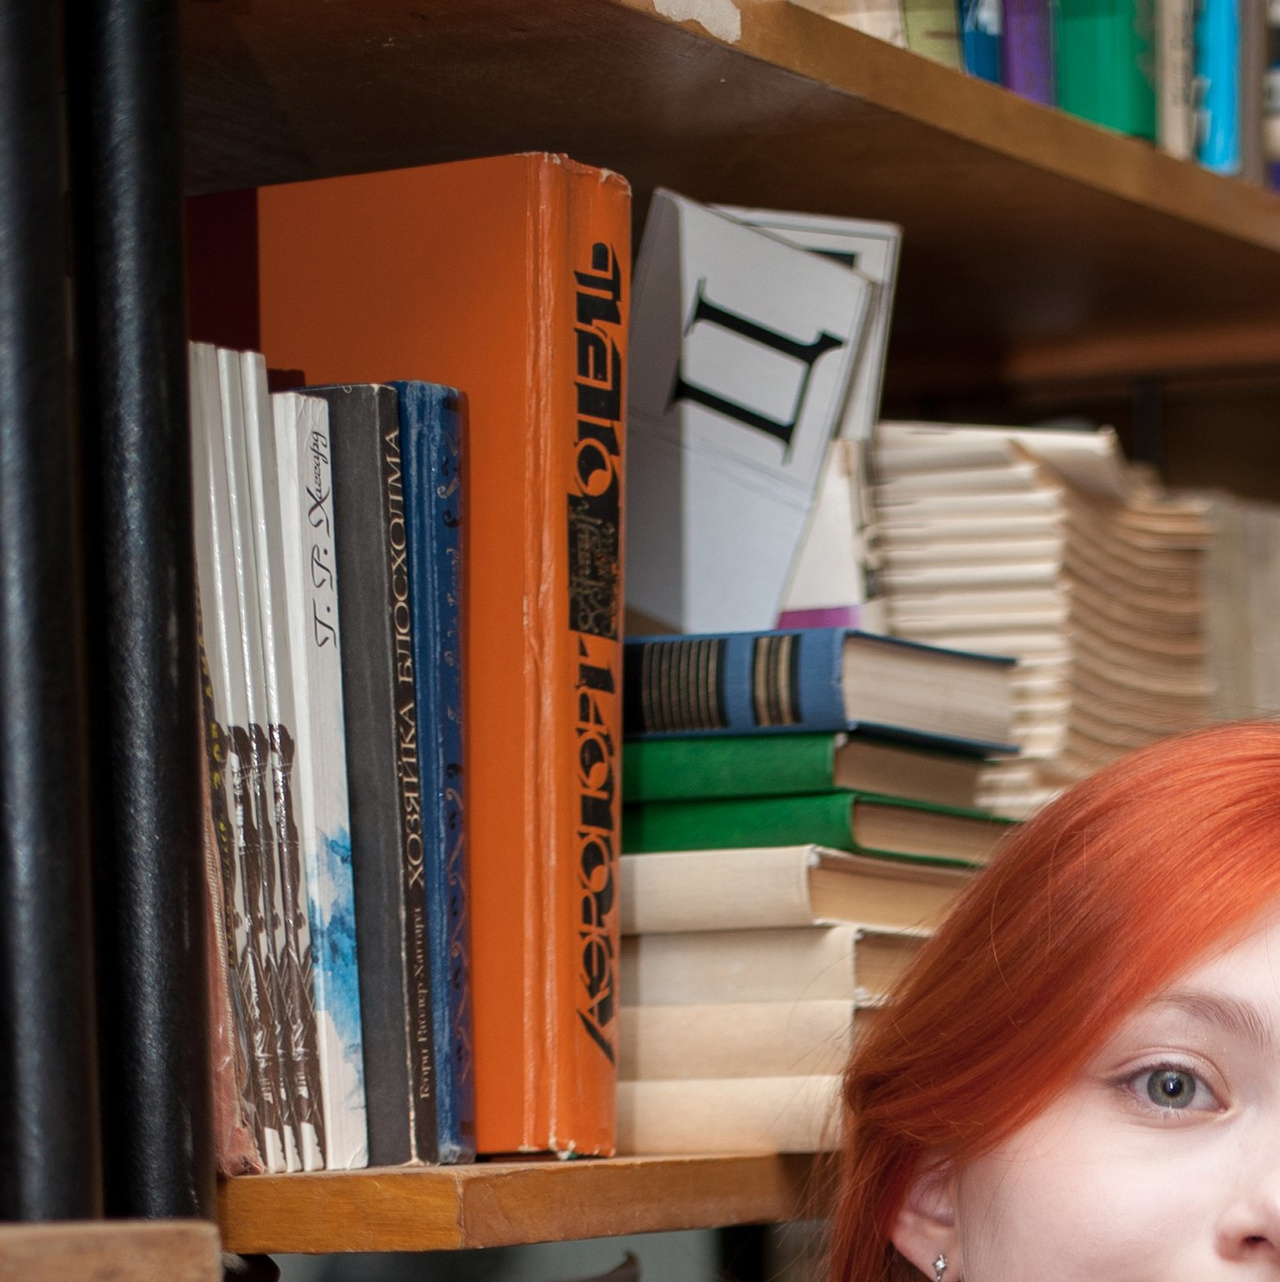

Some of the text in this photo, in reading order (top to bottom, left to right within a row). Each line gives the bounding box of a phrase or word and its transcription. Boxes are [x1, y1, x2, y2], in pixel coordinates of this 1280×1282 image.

[306, 431, 331, 538] Хаггард
[573, 241, 622, 497] ОТЕЛЬ
[311, 544, 334, 592] Р.
[384, 427, 425, 889] ХОЗЯЙКА БЛОСХОЛМА
[575, 632, 616, 1066] АЭРОПОРТ
